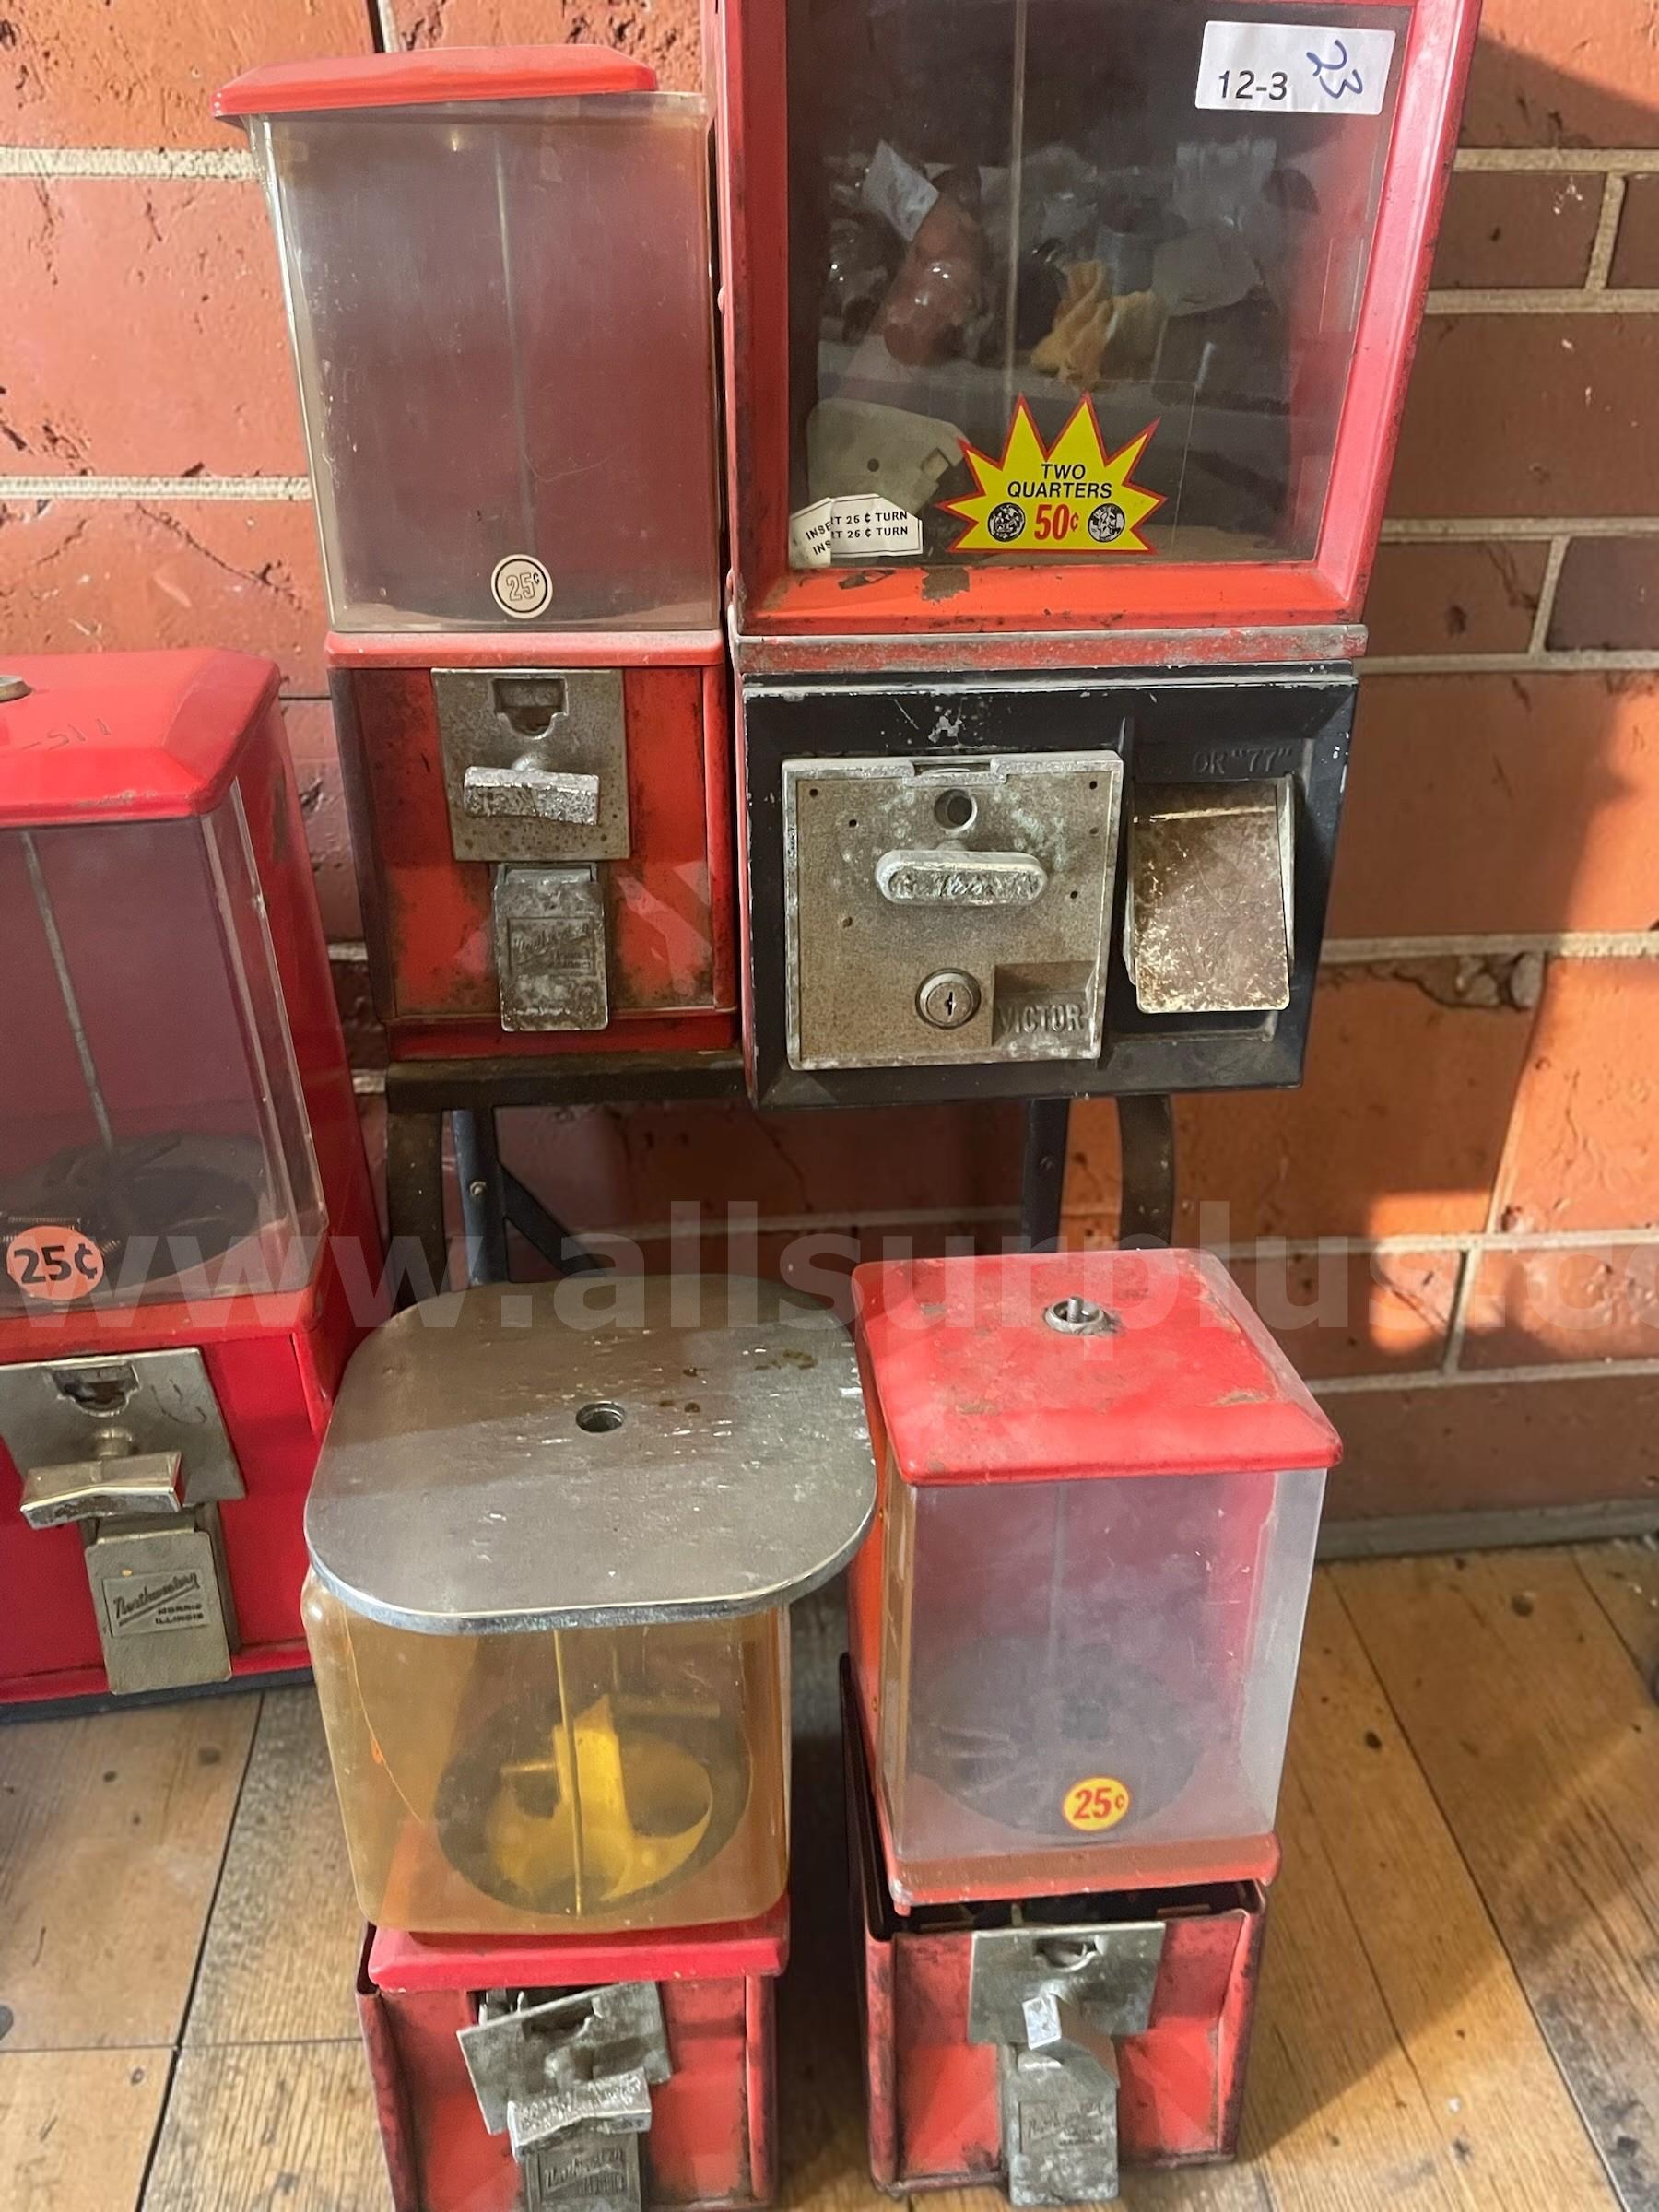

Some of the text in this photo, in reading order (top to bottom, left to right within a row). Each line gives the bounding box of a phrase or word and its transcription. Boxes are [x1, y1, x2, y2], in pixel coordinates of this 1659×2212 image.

[1218, 69, 1288, 100] 12-3
[1041, 464, 1086, 480] TWO
[1007, 481, 1112, 499] QUARTERS
[876, 511, 908, 522] TURN
[1033, 503, 1079, 541] 50¢
[876, 526, 908, 536] TURN
[996, 1001, 1083, 1033] VICTOR
[13, 1243, 98, 1285] 25¢
